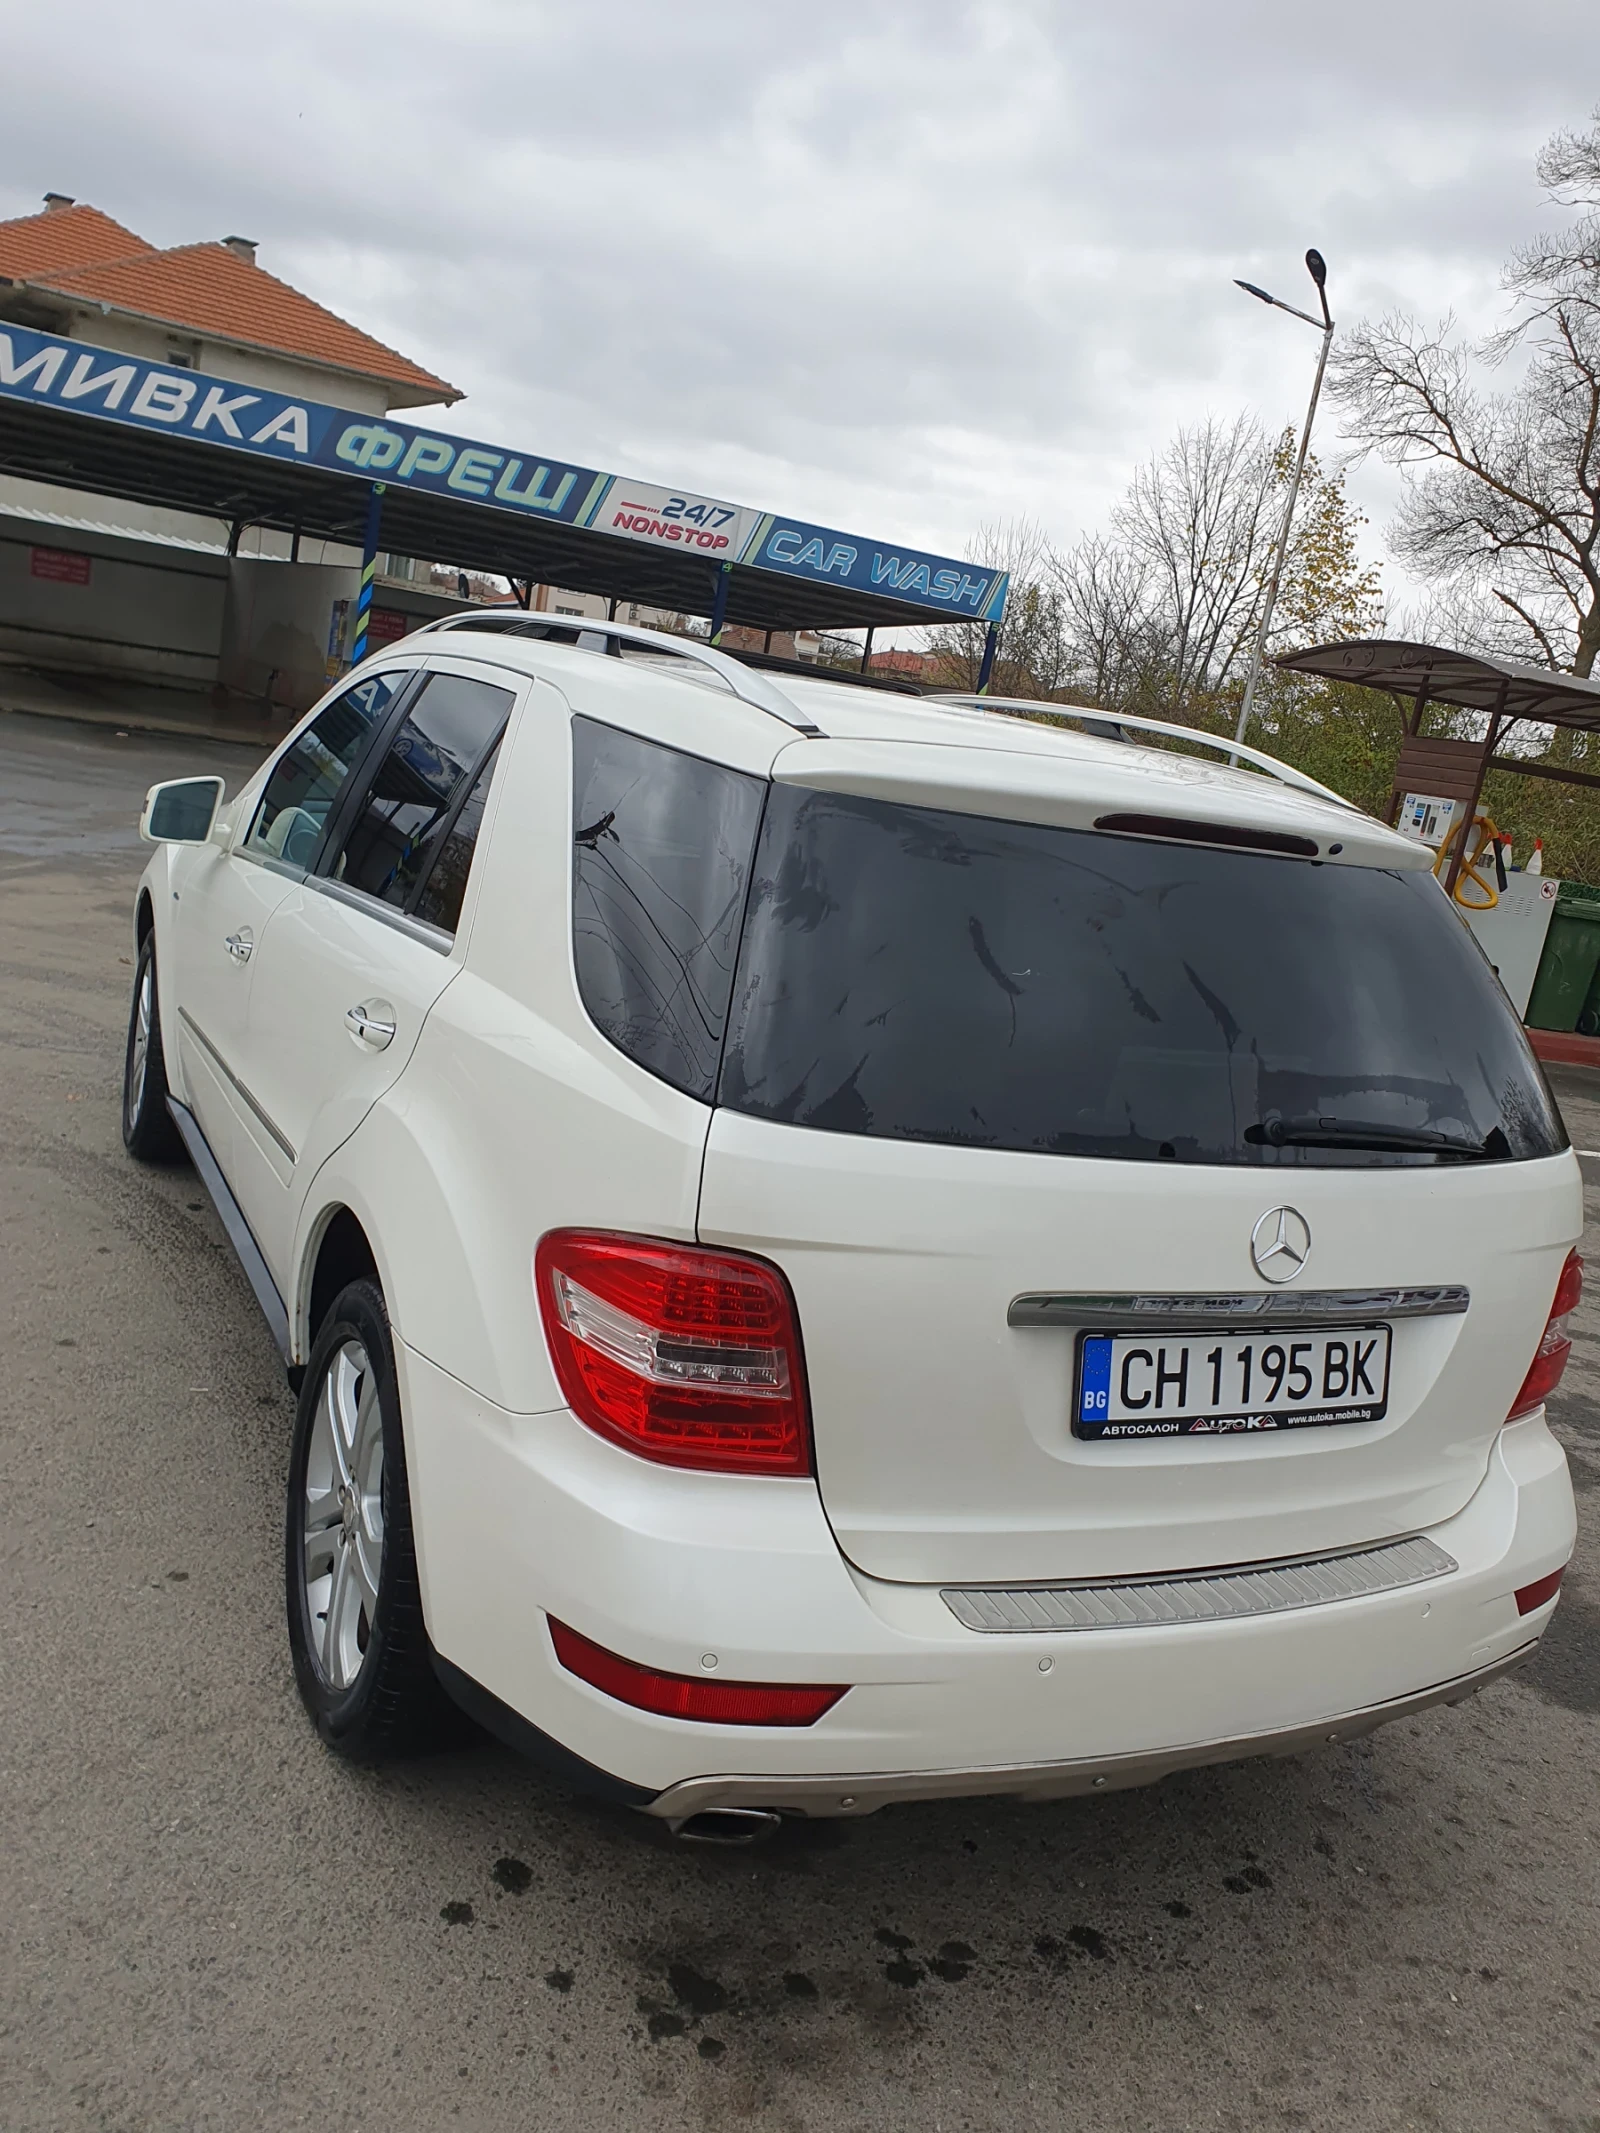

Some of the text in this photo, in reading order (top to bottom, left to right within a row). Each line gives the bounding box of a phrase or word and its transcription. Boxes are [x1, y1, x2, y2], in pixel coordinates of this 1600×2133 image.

[336, 424, 578, 513] ФРЕШ
[661, 498, 735, 528] 24/7
[612, 512, 729, 549] NONSTOP
[766, 530, 988, 606] CAR WASH
[1120, 1340, 1378, 1409] CH 1195 BK
[1084, 1391, 1106, 1409] BG
[1102, 1423, 1179, 1436] АВТОСАЛОН
[1287, 1409, 1371, 1425] www.autoka.mobile.bg
